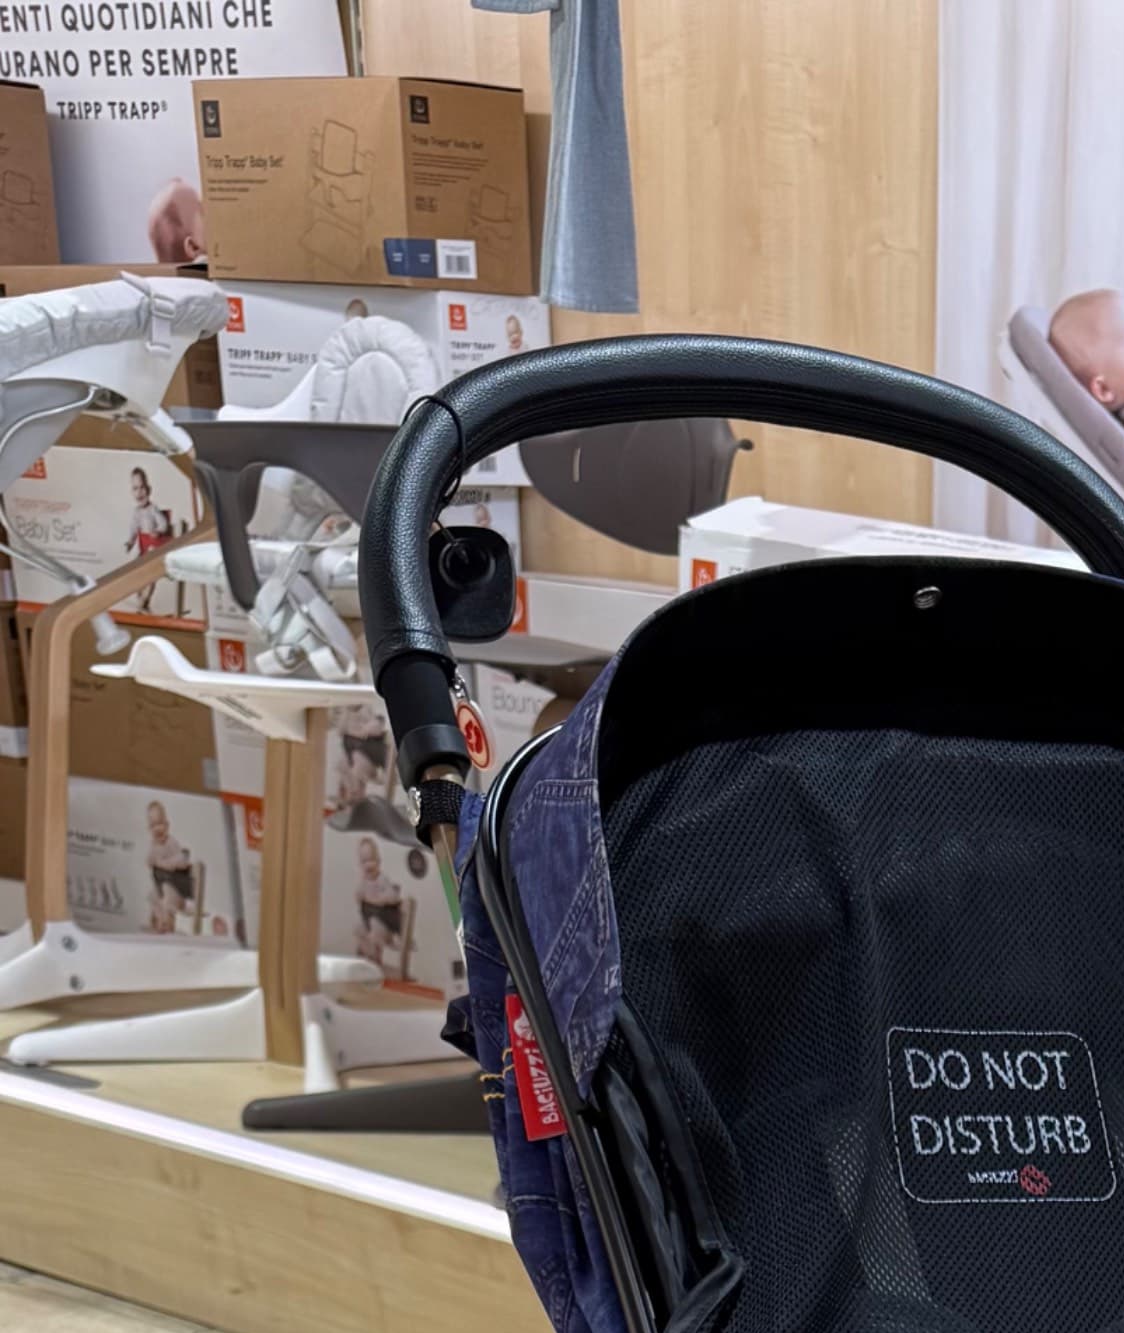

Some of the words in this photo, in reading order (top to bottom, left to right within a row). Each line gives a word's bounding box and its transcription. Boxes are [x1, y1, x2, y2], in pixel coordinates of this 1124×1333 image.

[61, 1, 213, 32] QUOTIDIANI
[222, 0, 273, 28] CHE
[89, 49, 133, 77] PER
[142, 48, 239, 76] SEMPRE
[56, 101, 102, 120] TRIPP
[904, 1048, 971, 1090] DO
[982, 1050, 1071, 1090] NOT
[910, 1114, 1092, 1155] DISTURB
